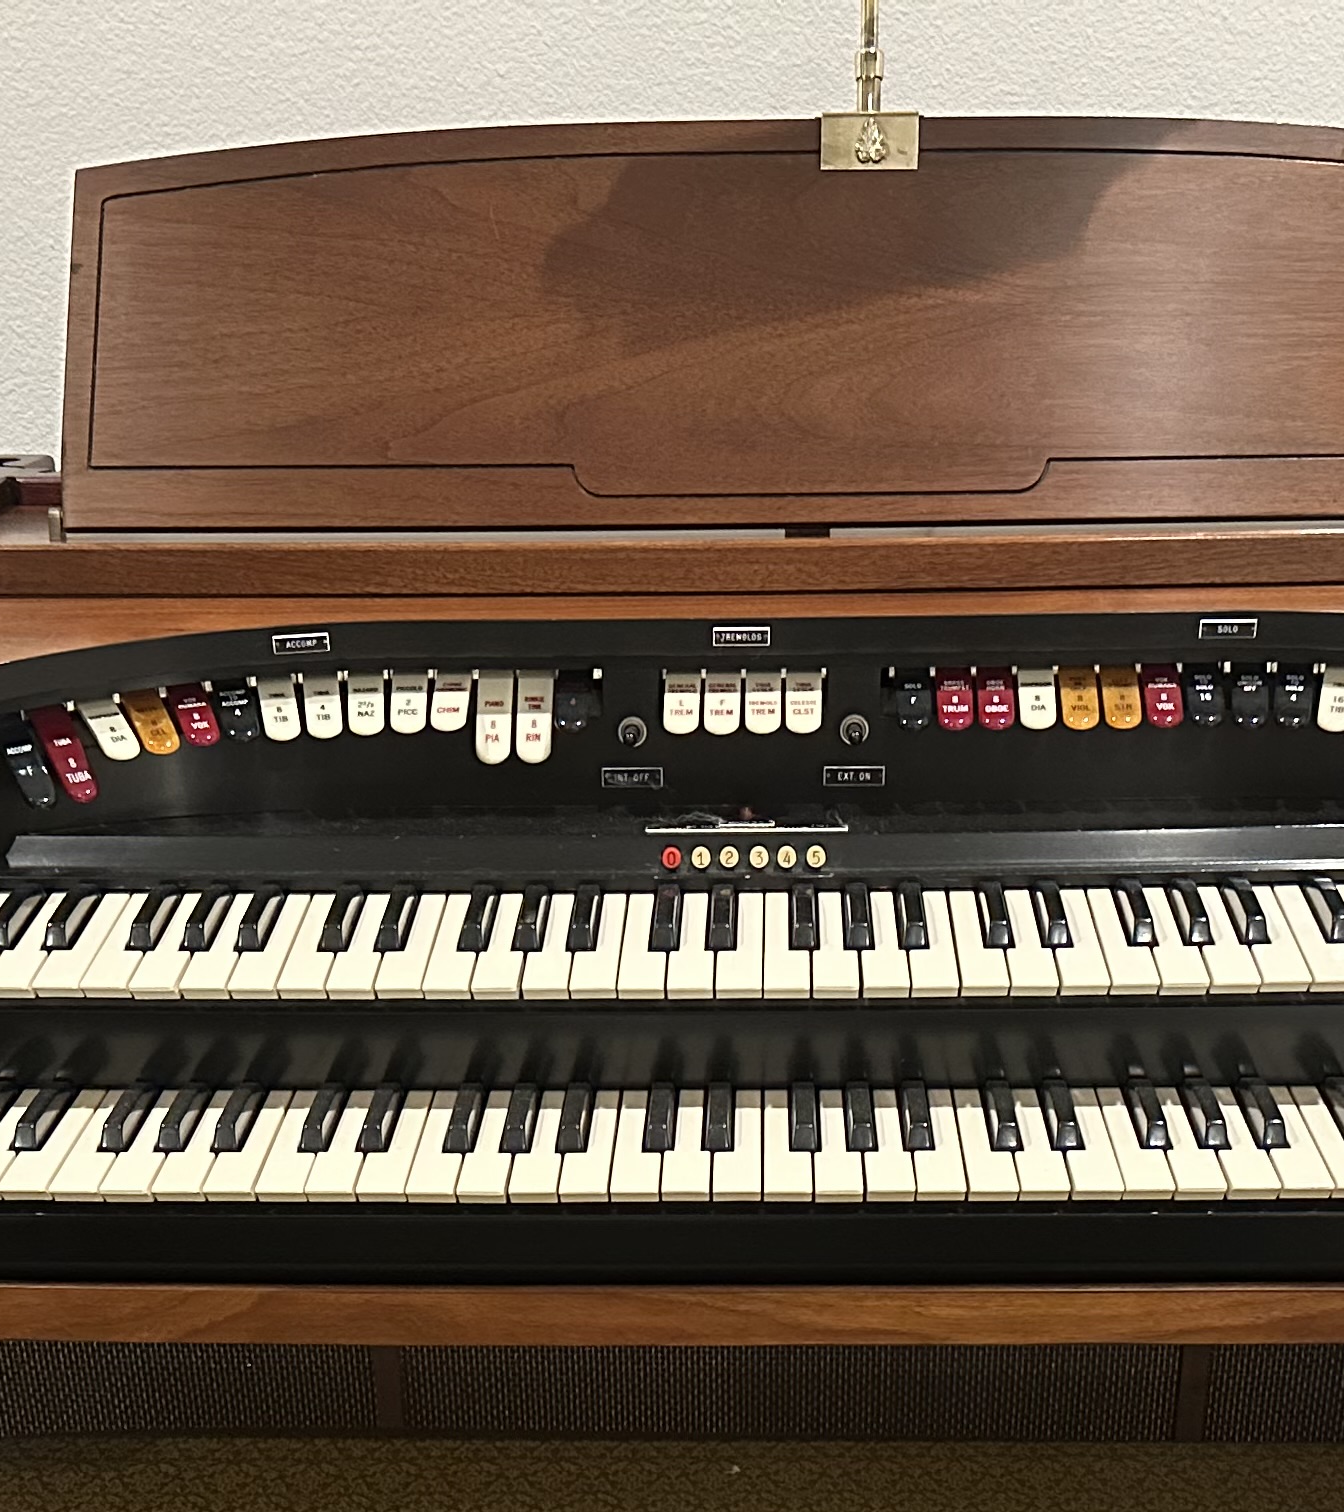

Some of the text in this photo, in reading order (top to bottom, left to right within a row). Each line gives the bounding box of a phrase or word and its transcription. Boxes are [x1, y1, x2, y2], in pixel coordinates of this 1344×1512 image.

[1217, 625, 1238, 634] SOLO
[286, 638, 318, 649] ACCOMP
[1200, 692, 1212, 701] 16
[1290, 693, 1297, 701] 4
[942, 705, 969, 713] TRUM
[985, 705, 1009, 713] OBOE
[1156, 702, 1175, 710] VOX
[1330, 705, 1344, 713] TIB
[398, 708, 418, 716] PICC
[490, 720, 496, 729] 8
[531, 719, 537, 728] 8
[110, 734, 127, 743] DIA
[485, 734, 500, 744] PIA
[526, 733, 541, 742] RIN
[67, 757, 77, 768] 8
[65, 770, 92, 784] TUBA
[633, 771, 650, 782] OFF
[837, 772, 871, 782] EXT ON
[667, 850, 820, 866] 0 1 2 3 4 5
